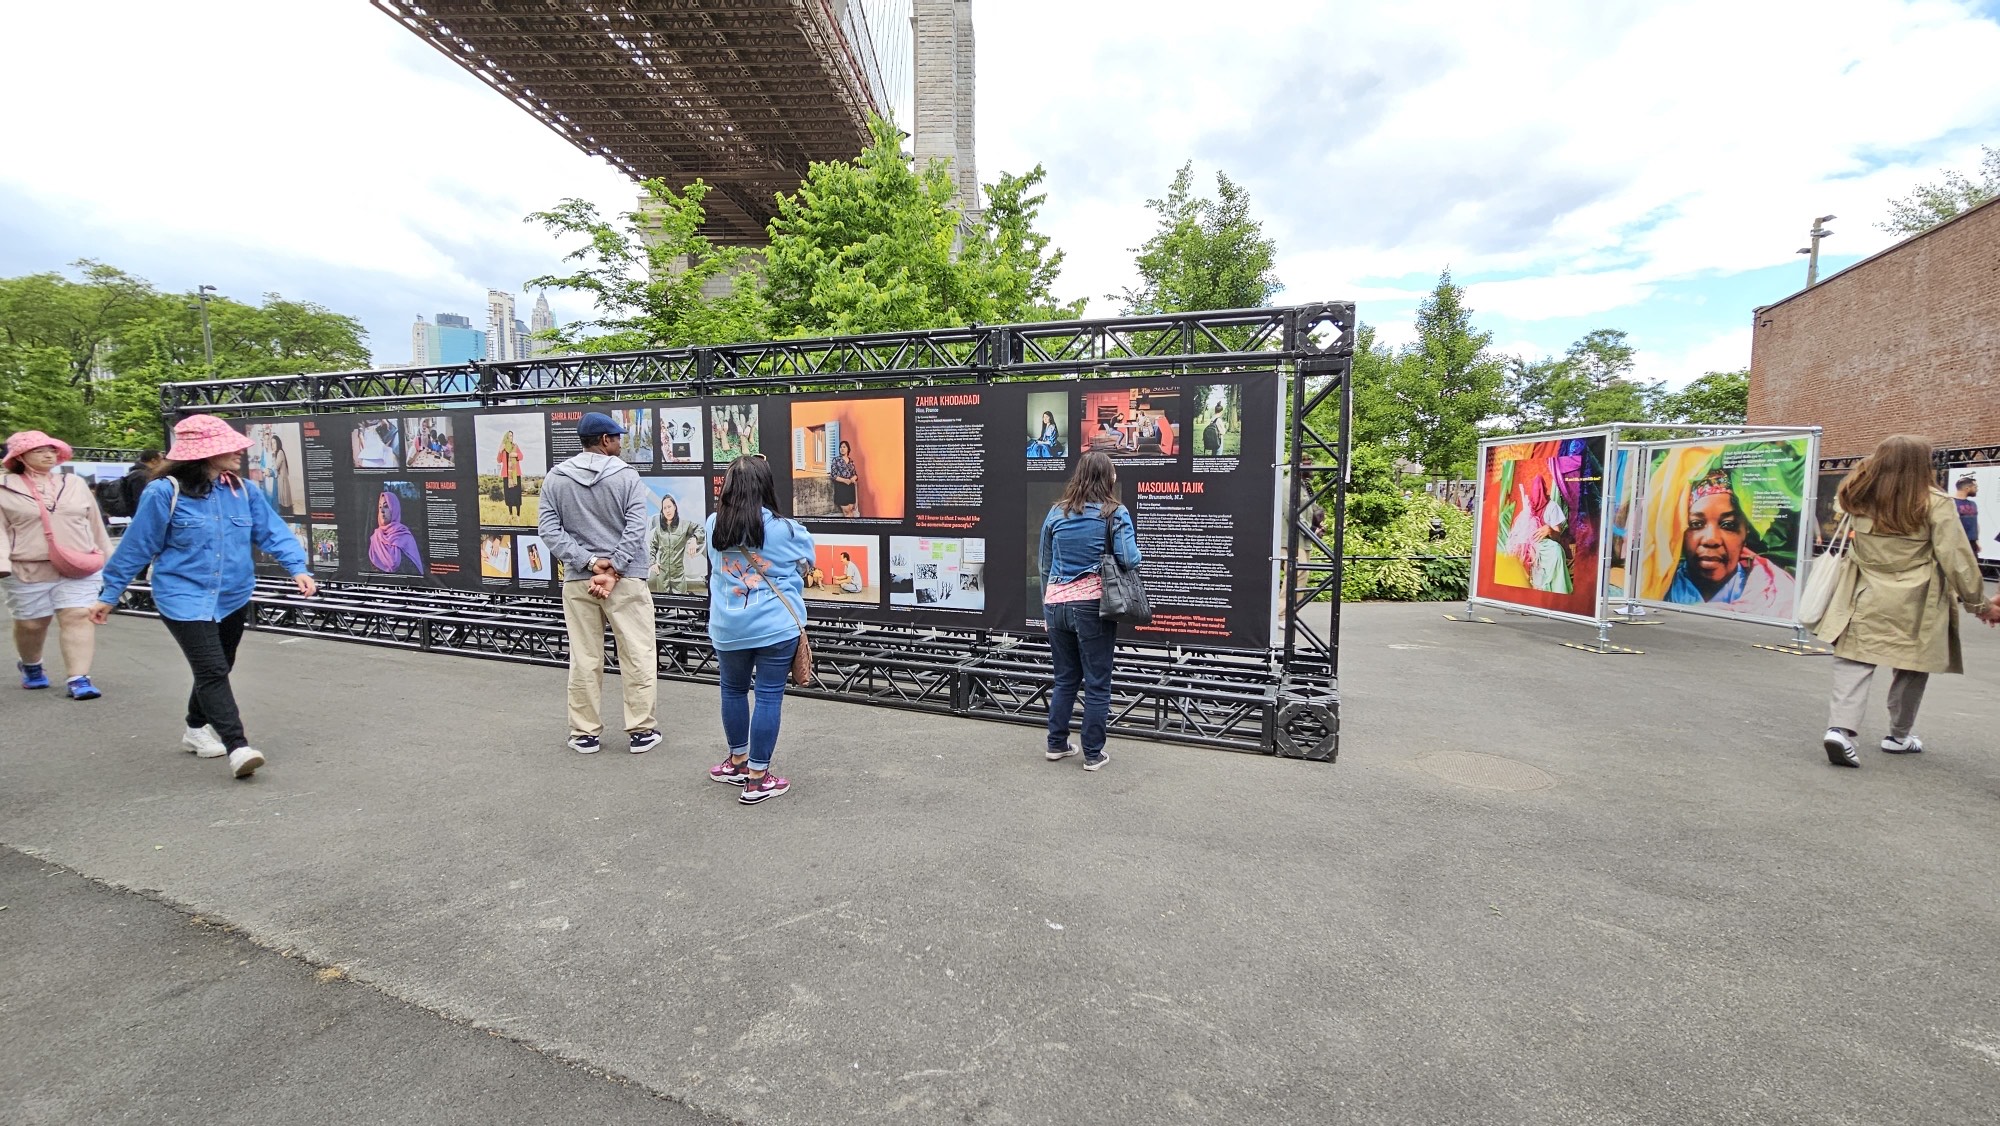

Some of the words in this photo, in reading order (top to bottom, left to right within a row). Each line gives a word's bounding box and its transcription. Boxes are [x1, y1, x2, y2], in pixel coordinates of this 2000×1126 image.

[916, 396, 938, 406] ZAHRA
[940, 394, 980, 406] KHODADADI
[551, 412, 567, 420] SAHRA
[1138, 482, 1180, 493] MASOUMA
[1182, 482, 1204, 493] TAJIK
